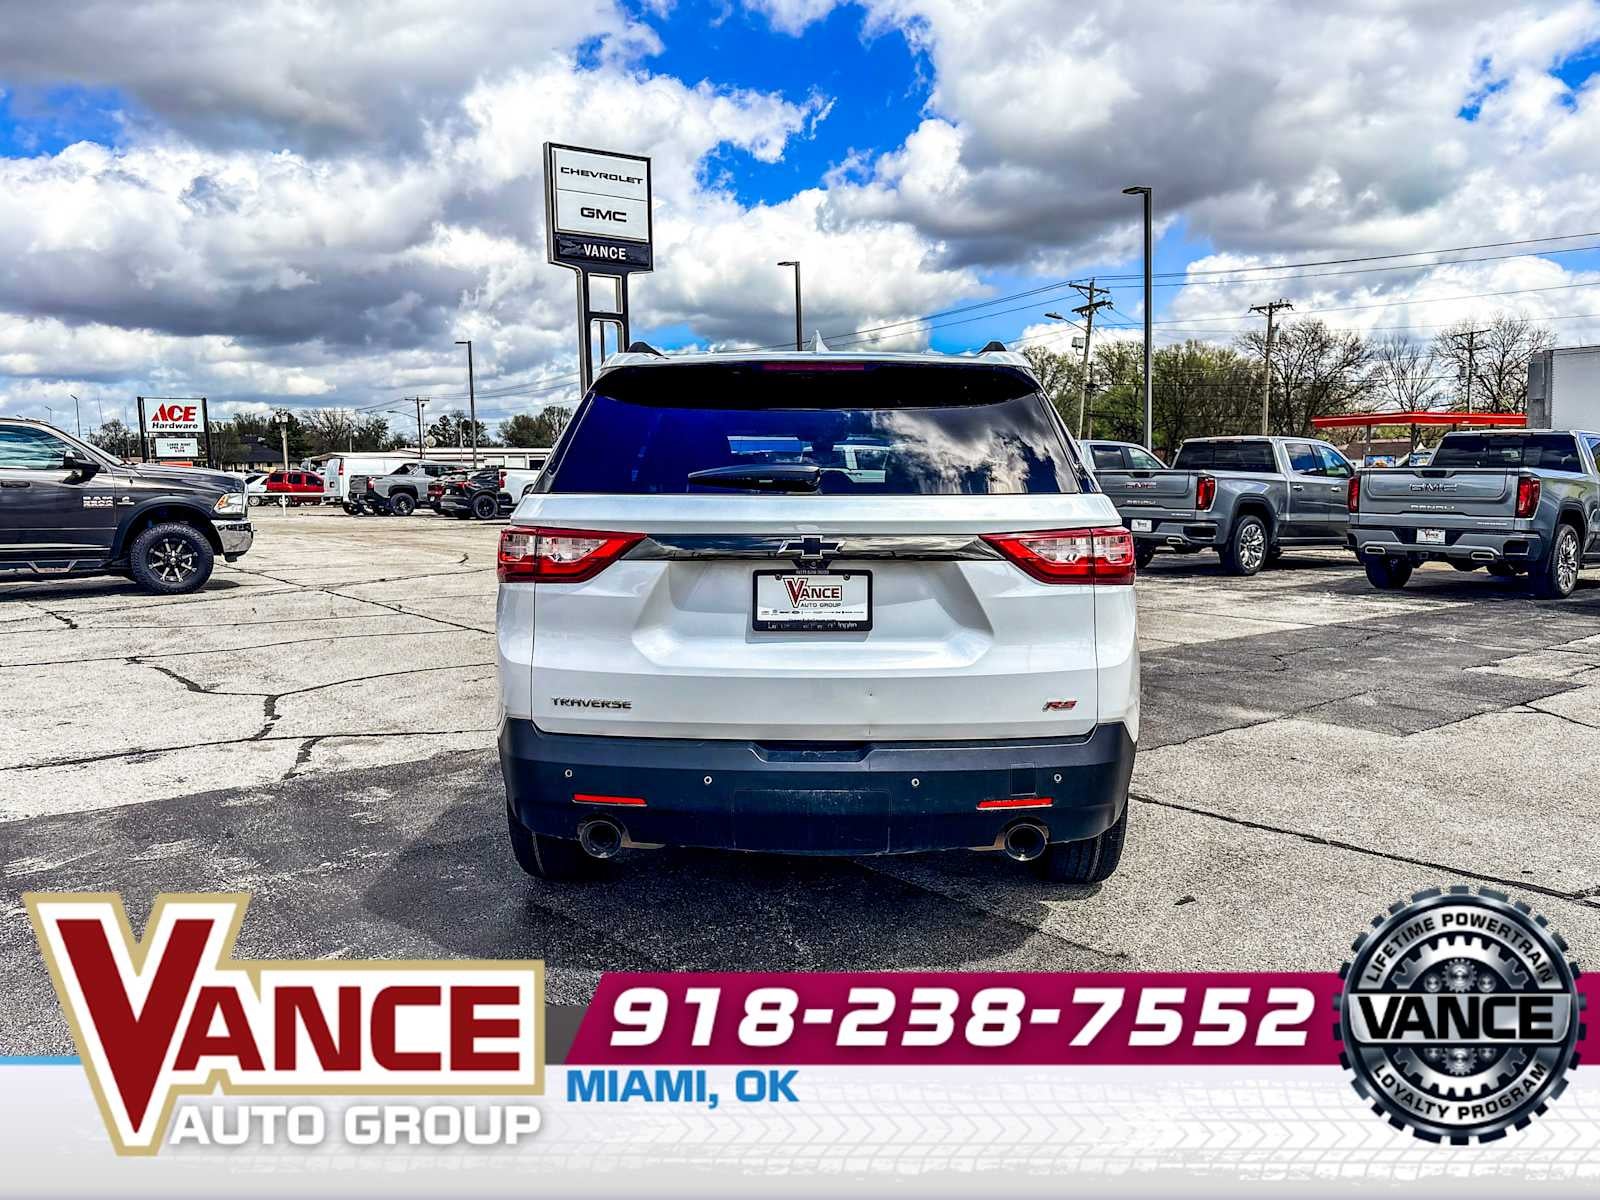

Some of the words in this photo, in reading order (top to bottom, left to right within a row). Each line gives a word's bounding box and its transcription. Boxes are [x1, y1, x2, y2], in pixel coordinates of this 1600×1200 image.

[560, 166, 643, 184] CHEVROLET
[580, 207, 627, 222] GMC
[583, 244, 627, 260] VANCE
[151, 403, 197, 422] ACE
[1410, 482, 1457, 492] GMC
[785, 579, 842, 607] VANCE
[551, 697, 632, 709] TRAVERSE
[1042, 700, 1078, 712] RS
